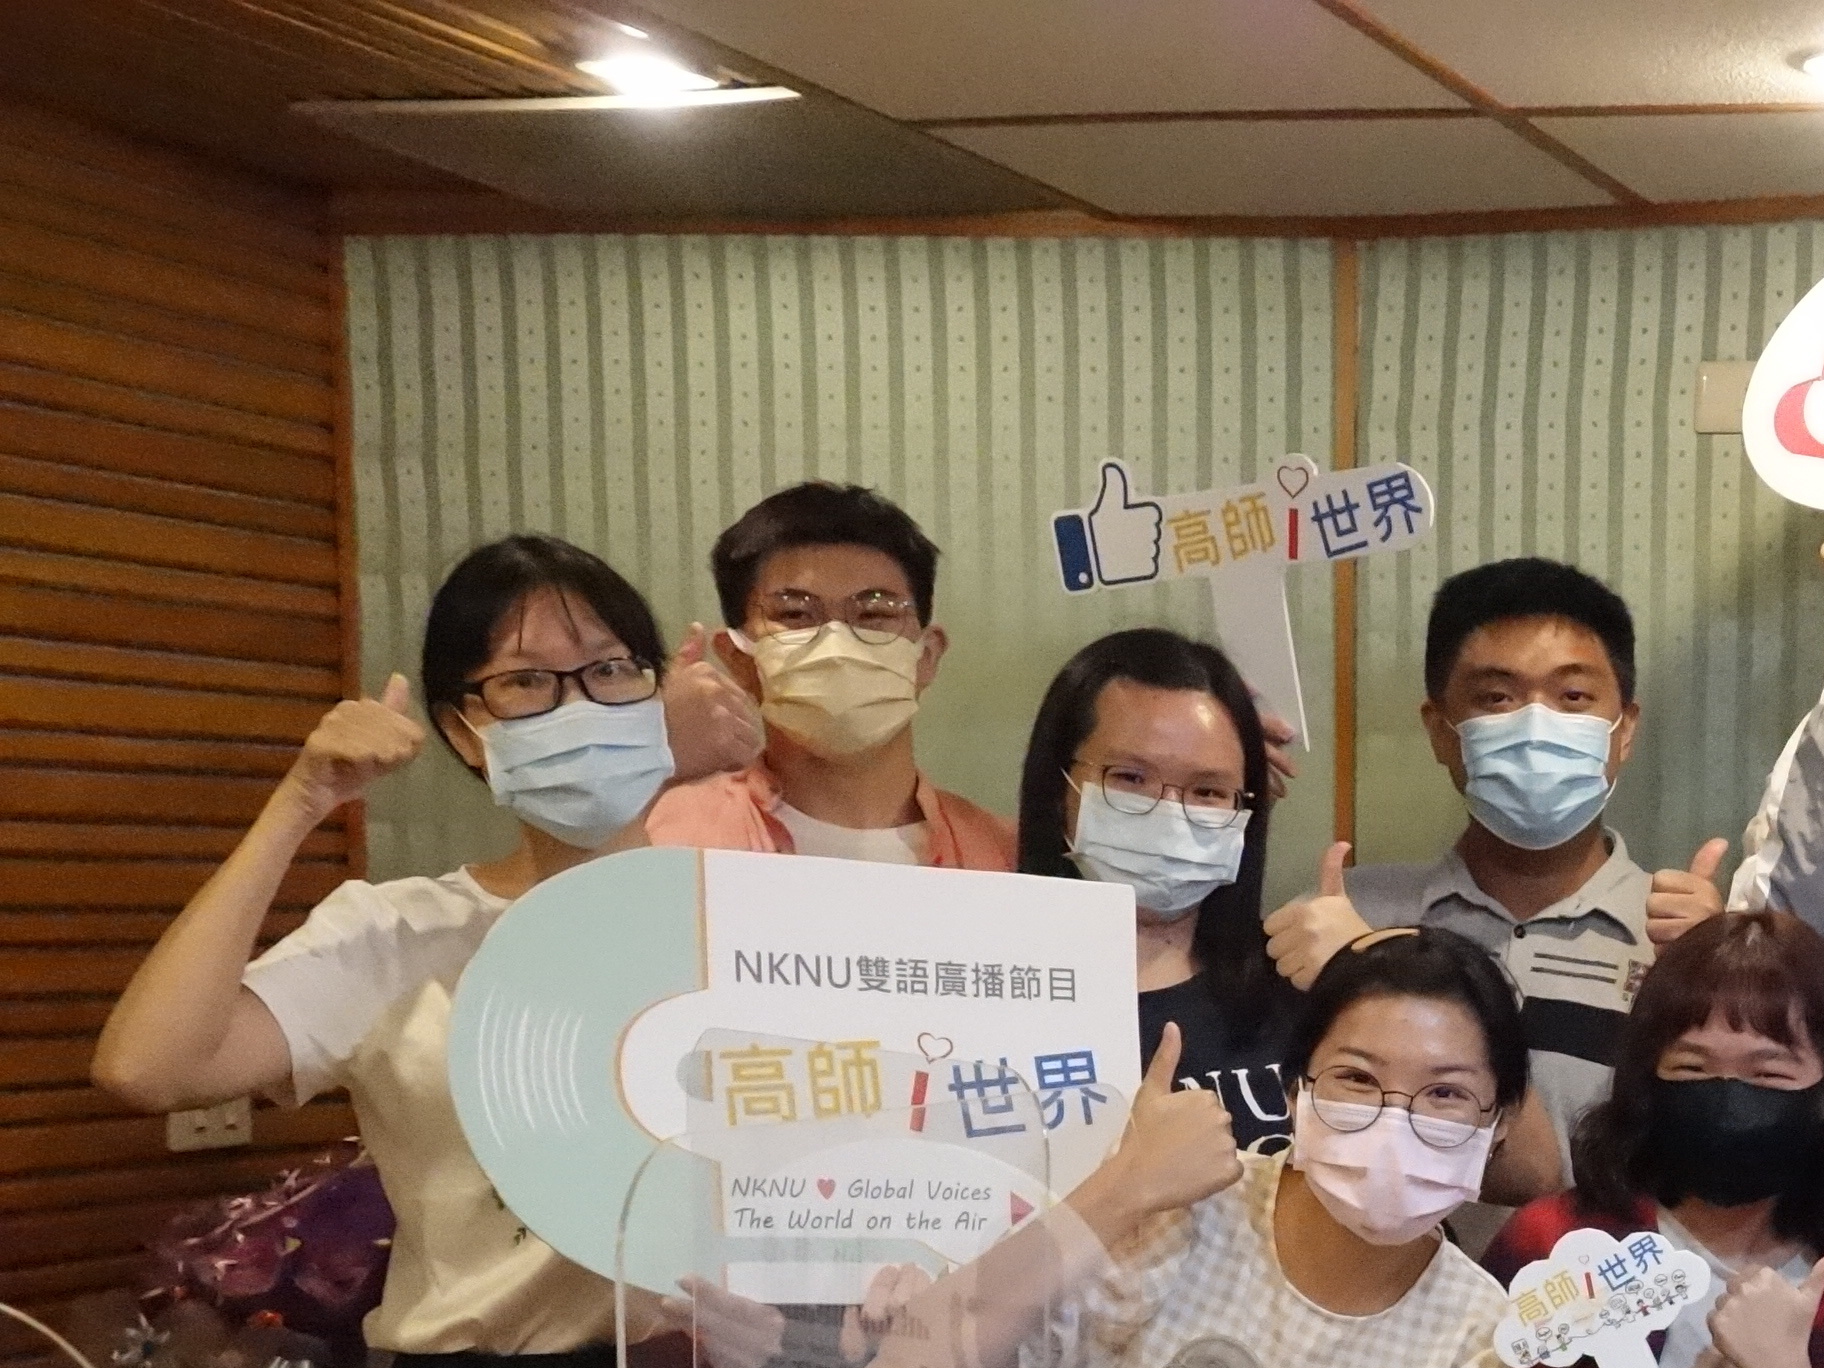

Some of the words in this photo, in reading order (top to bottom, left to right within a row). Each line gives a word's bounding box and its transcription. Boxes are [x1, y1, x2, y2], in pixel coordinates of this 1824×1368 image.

[734, 950, 1079, 1003] NKNU雙語廣播節目
[731, 1176, 806, 1198] NKNU
[847, 1178, 914, 1200] Global
[927, 1181, 992, 1201] Voices
[734, 1207, 774, 1229] The
[788, 1208, 853, 1230] World
[866, 1212, 891, 1229] on
[906, 1208, 942, 1230] the
[954, 1209, 988, 1231] Air
